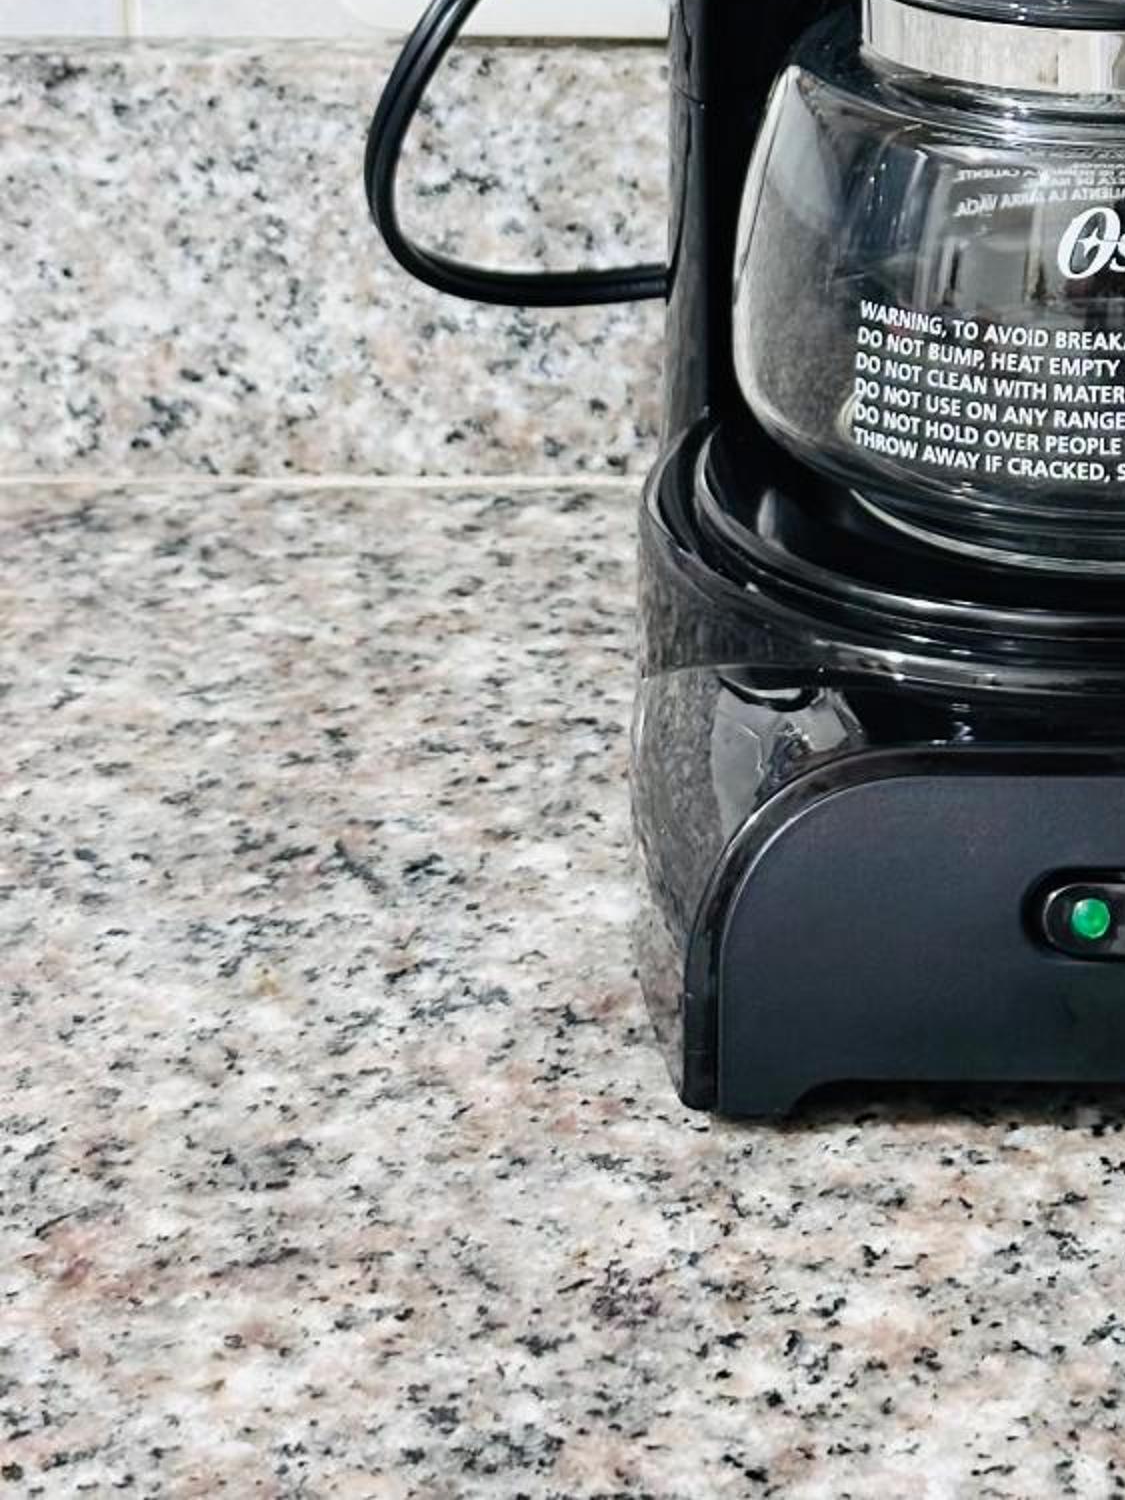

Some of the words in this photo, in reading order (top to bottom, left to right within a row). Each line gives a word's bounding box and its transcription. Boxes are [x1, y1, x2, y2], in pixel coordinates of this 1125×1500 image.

[861, 300, 948, 338] WARNING,
[953, 319, 979, 341] TO
[983, 325, 1049, 348] AVOID
[855, 351, 881, 374] DO
[884, 360, 923, 384] NOT
[926, 368, 988, 396] CLEAN
[993, 378, 1048, 401] WITH
[857, 326, 883, 348] DO
[886, 334, 925, 358] NOT
[928, 342, 985, 371] BUMP,
[991, 352, 1044, 375] HEAT
[1049, 359, 1120, 378] EMPTY
[854, 377, 880, 401] DO
[883, 384, 922, 410] NOT
[925, 396, 962, 418] USE
[966, 401, 998, 424] ON
[1002, 407, 1049, 427] ANY
[853, 402, 880, 425] DO
[883, 410, 921, 435] NOT
[925, 420, 980, 446] HOLD
[984, 430, 1041, 453] OVER
[1045, 435, 1123, 457] PEOPLE
[853, 425, 919, 461] THROW
[922, 444, 982, 472] AWAY
[985, 454, 1004, 474] IF
[1007, 457, 1112, 484] CRACKED,
